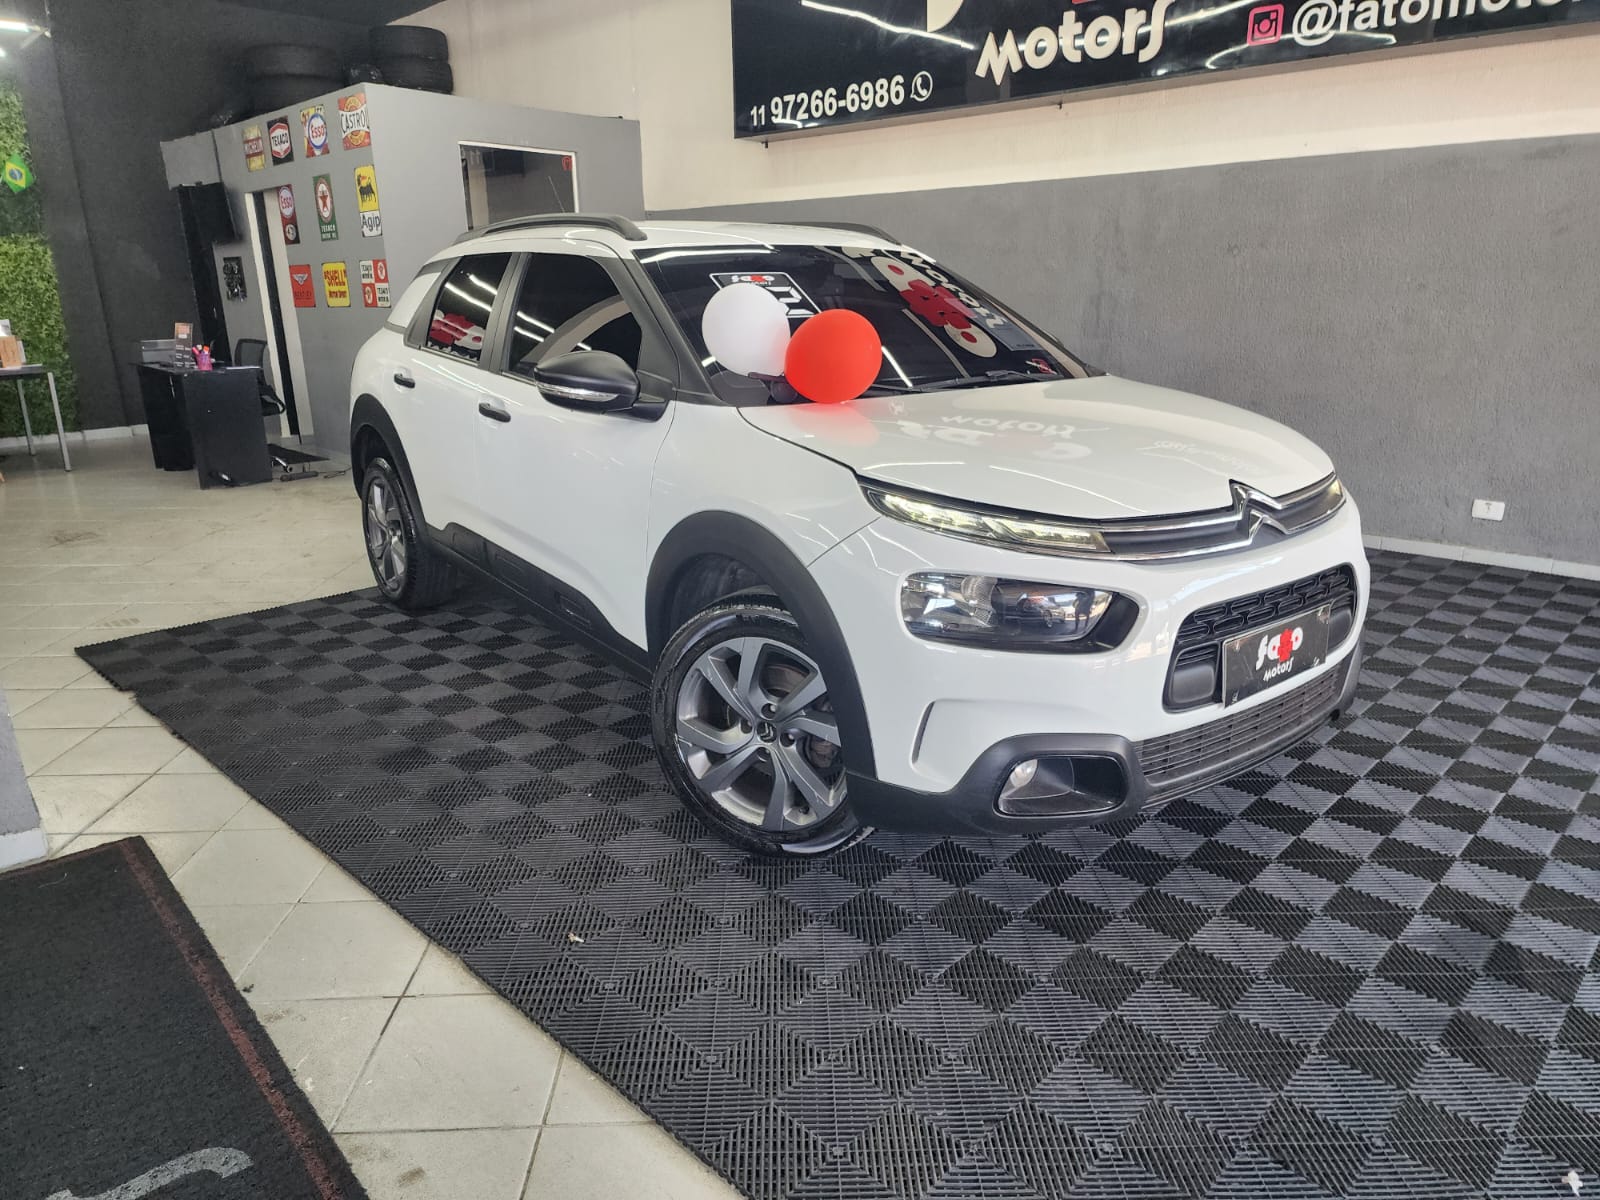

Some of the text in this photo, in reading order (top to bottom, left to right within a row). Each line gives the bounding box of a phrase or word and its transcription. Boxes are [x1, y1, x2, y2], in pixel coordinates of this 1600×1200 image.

[975, 0, 1166, 86] Motors
[750, 75, 905, 127] 11 97266-6986
[272, 133, 289, 147] TEXACO
[361, 214, 381, 232] Agip
